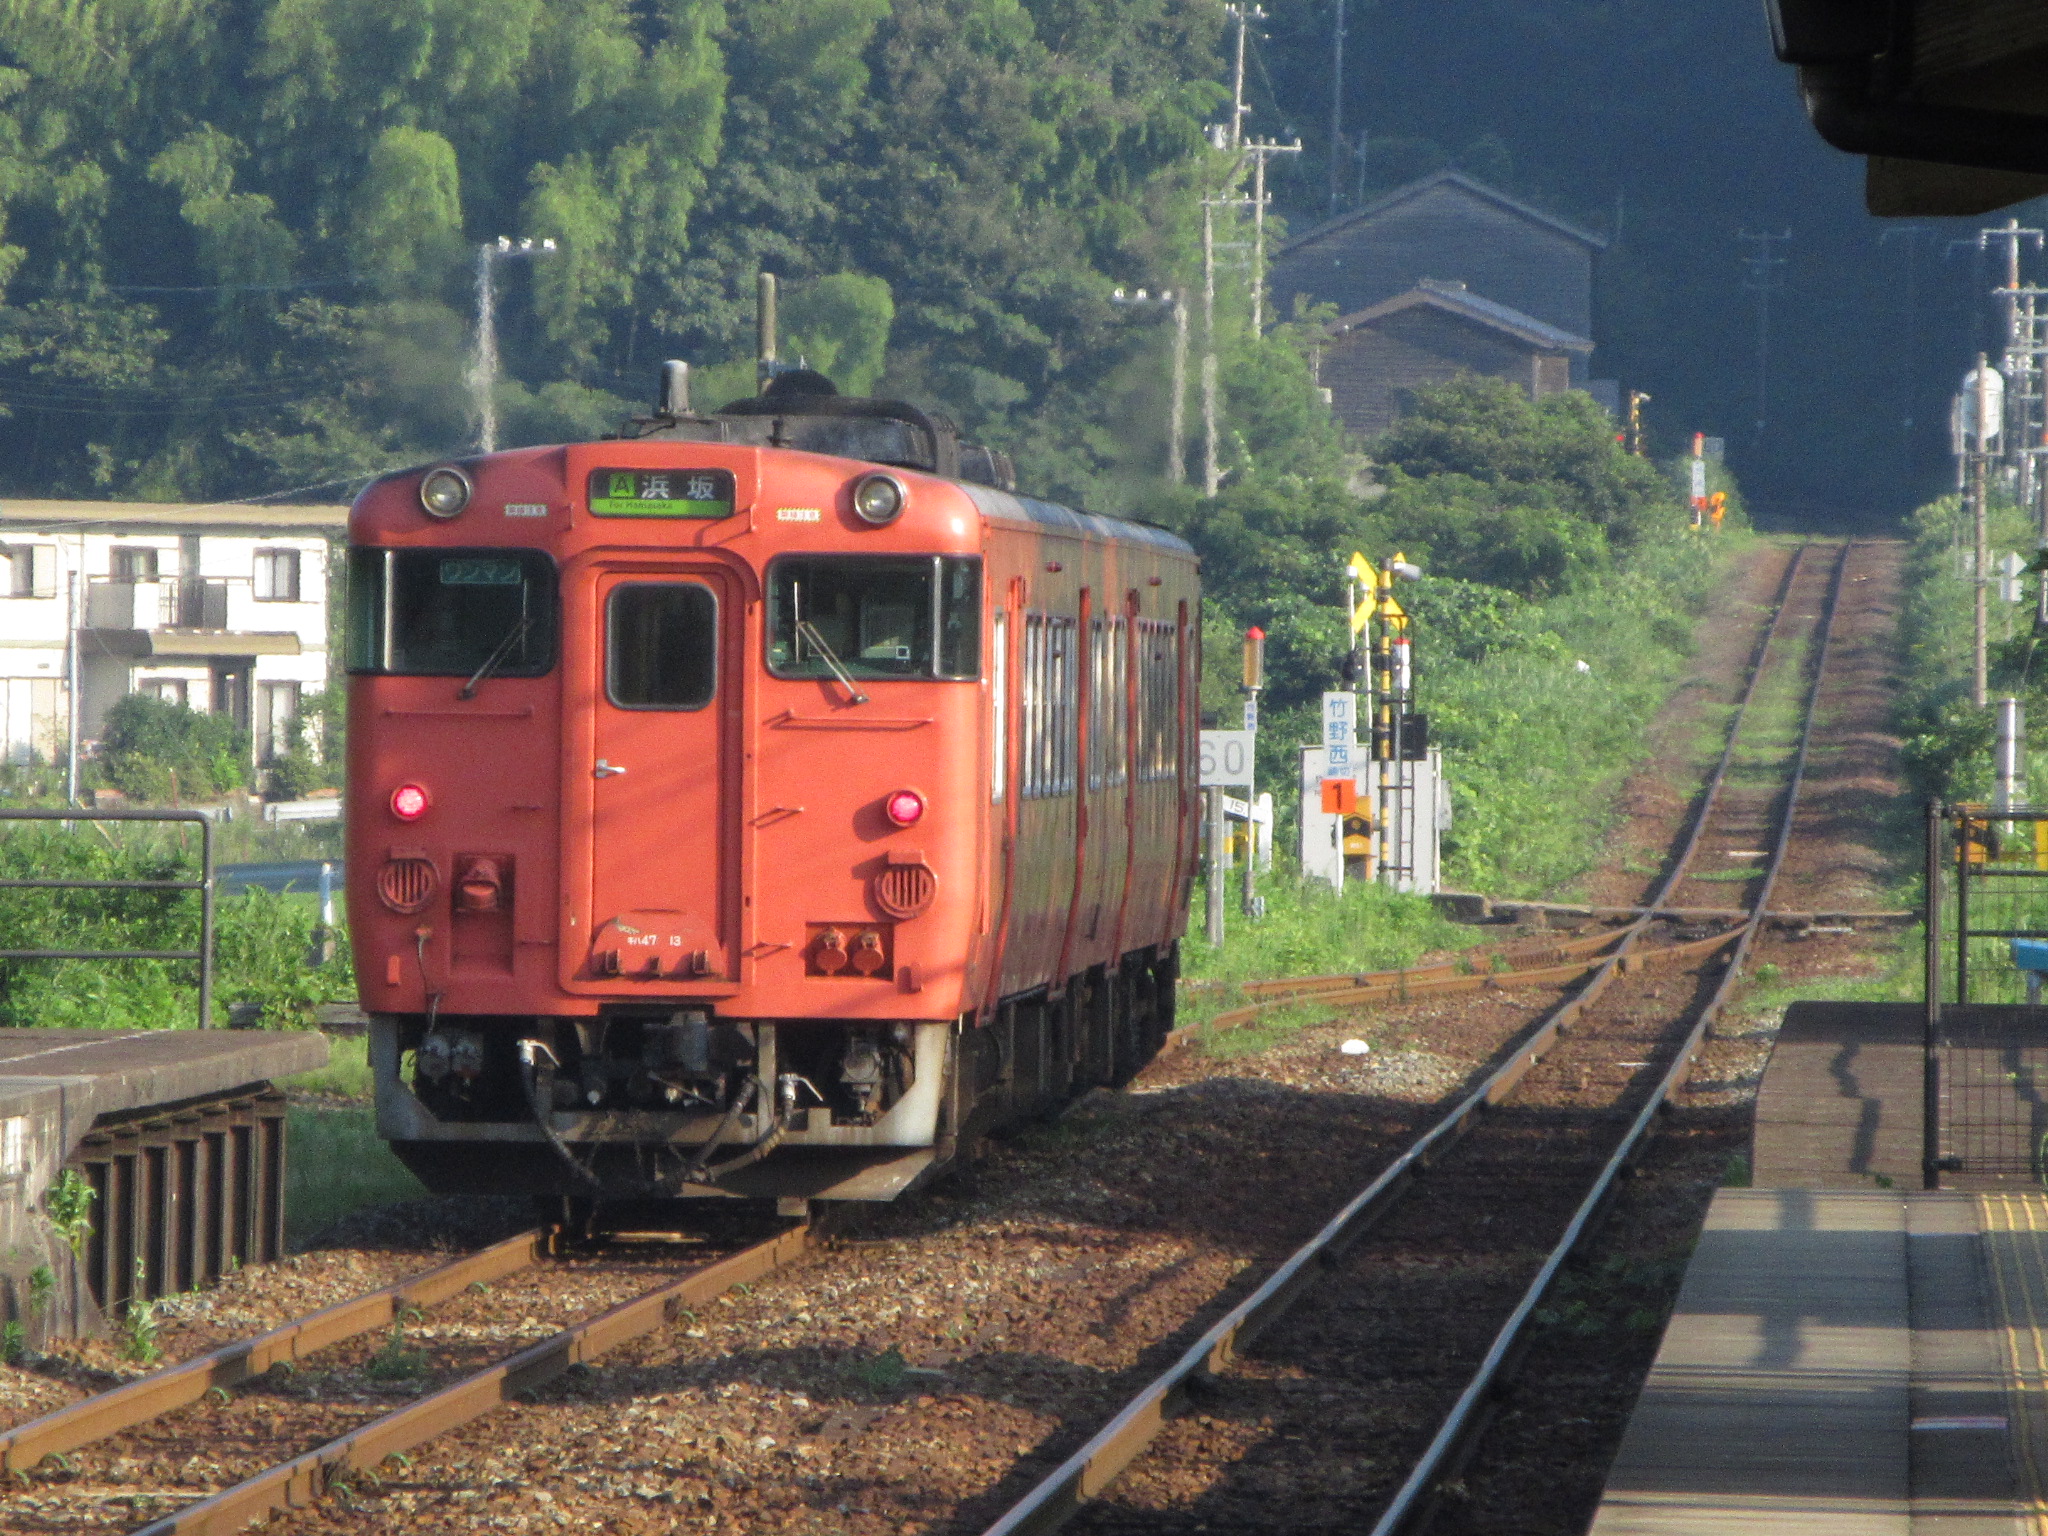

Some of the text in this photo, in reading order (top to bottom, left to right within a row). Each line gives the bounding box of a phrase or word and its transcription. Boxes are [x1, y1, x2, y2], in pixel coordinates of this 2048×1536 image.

[614, 474, 714, 500] A 浜坂
[1329, 698, 1348, 764] 竹野西
[1200, 739, 1245, 775] 60
[1333, 782, 1342, 810] 1
[669, 935, 682, 947] 13
